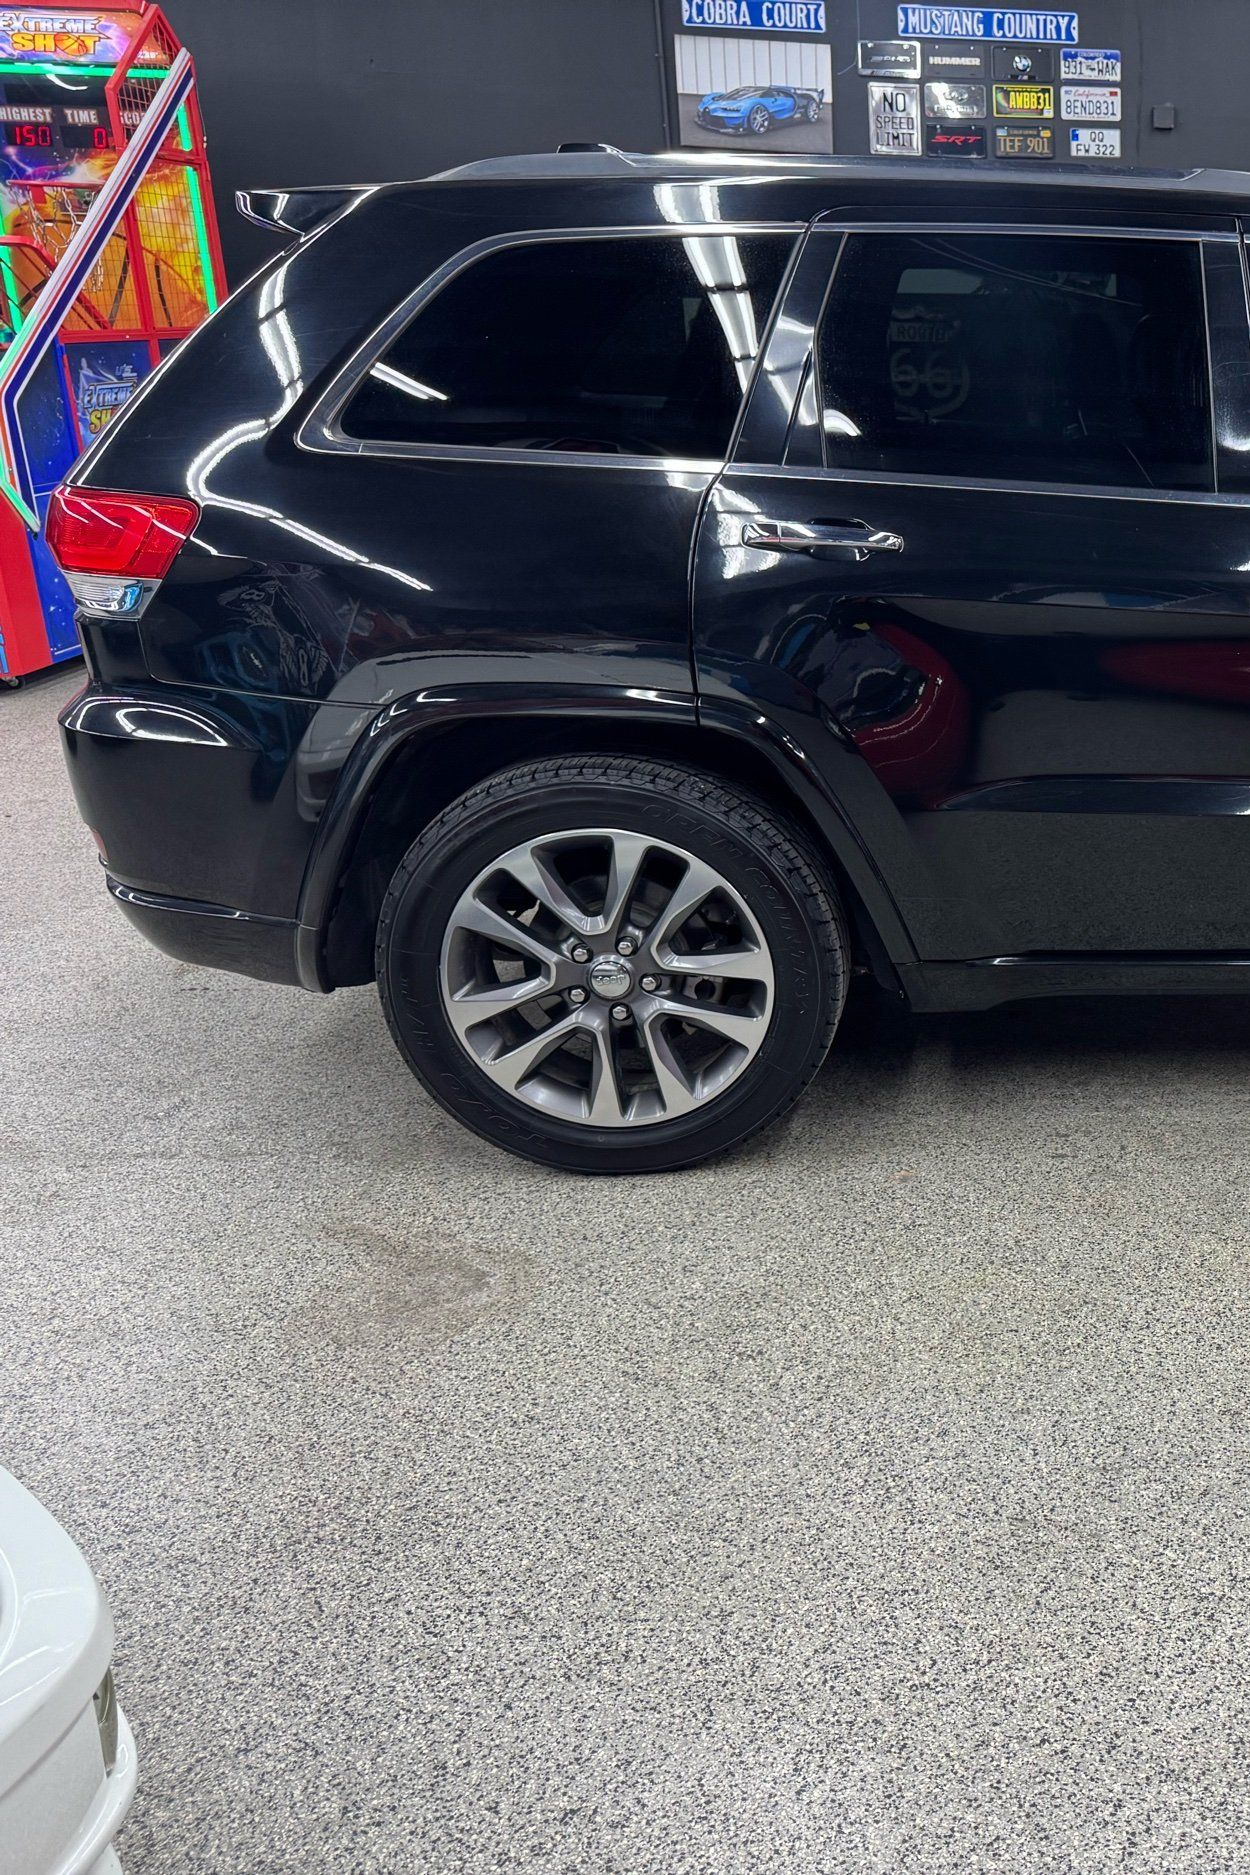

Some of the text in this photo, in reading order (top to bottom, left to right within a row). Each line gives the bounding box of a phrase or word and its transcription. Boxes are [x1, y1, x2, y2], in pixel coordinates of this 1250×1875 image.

[0, 12, 101, 33] EXTREME
[691, 0, 818, 29] COBRA COURT
[907, 8, 1070, 40] MUSTANG COUNTRY
[11, 32, 100, 56] SHOT
[928, 56, 981, 66] HUMMER
[1063, 60, 1118, 76] 931 WAK
[882, 91, 907, 113] NO
[1065, 99, 1117, 117] 8END831
[0, 107, 98, 123] HIGHEST TIME
[876, 115, 915, 130] SPEED
[15, 124, 52, 147] 150
[876, 132, 915, 147] LIMIT
[931, 135, 983, 146] SRT
[999, 137, 1051, 154] TEF 901
[1095, 144, 1116, 156] 322
